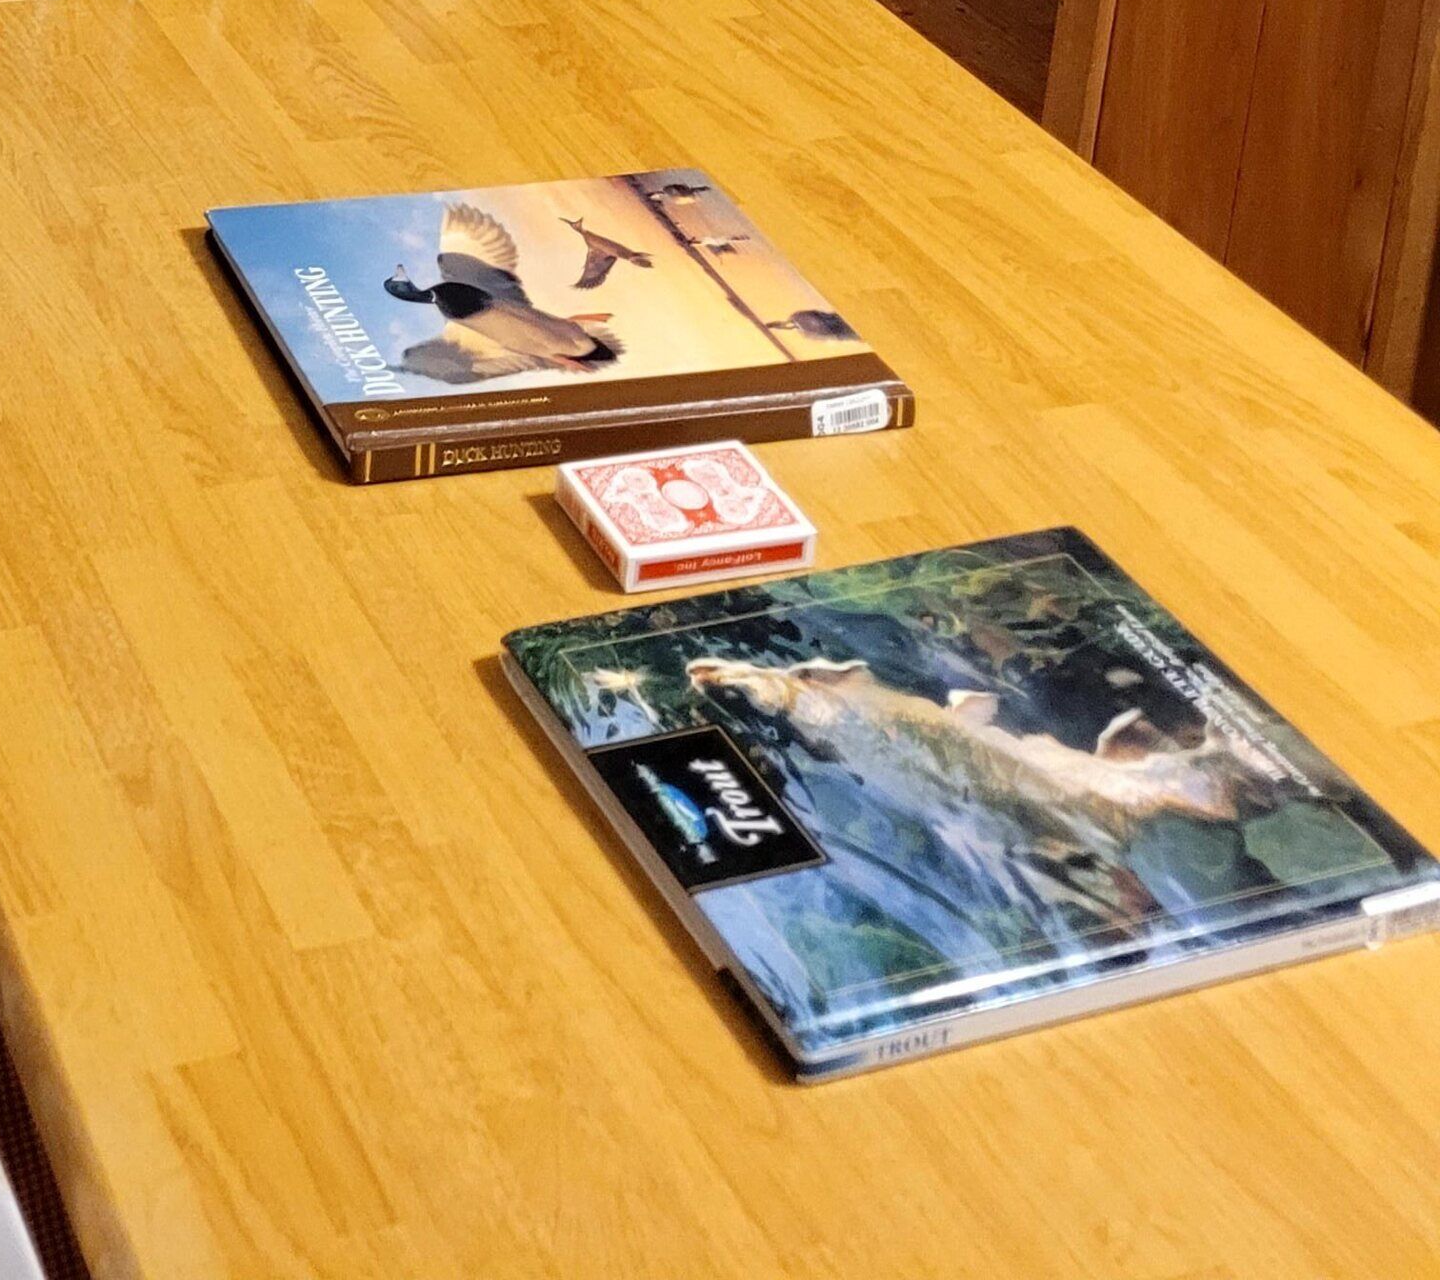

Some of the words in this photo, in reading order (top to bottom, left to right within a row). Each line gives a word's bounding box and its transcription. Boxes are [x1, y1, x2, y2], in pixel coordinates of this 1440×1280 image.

[294, 266, 370, 344] HUNTING
[345, 344, 406, 397] DUCK
[441, 446, 489, 467] DUCK
[490, 439, 562, 461] HUNTING
[688, 758, 785, 847] Trout
[877, 1027, 951, 1060] TROUT
